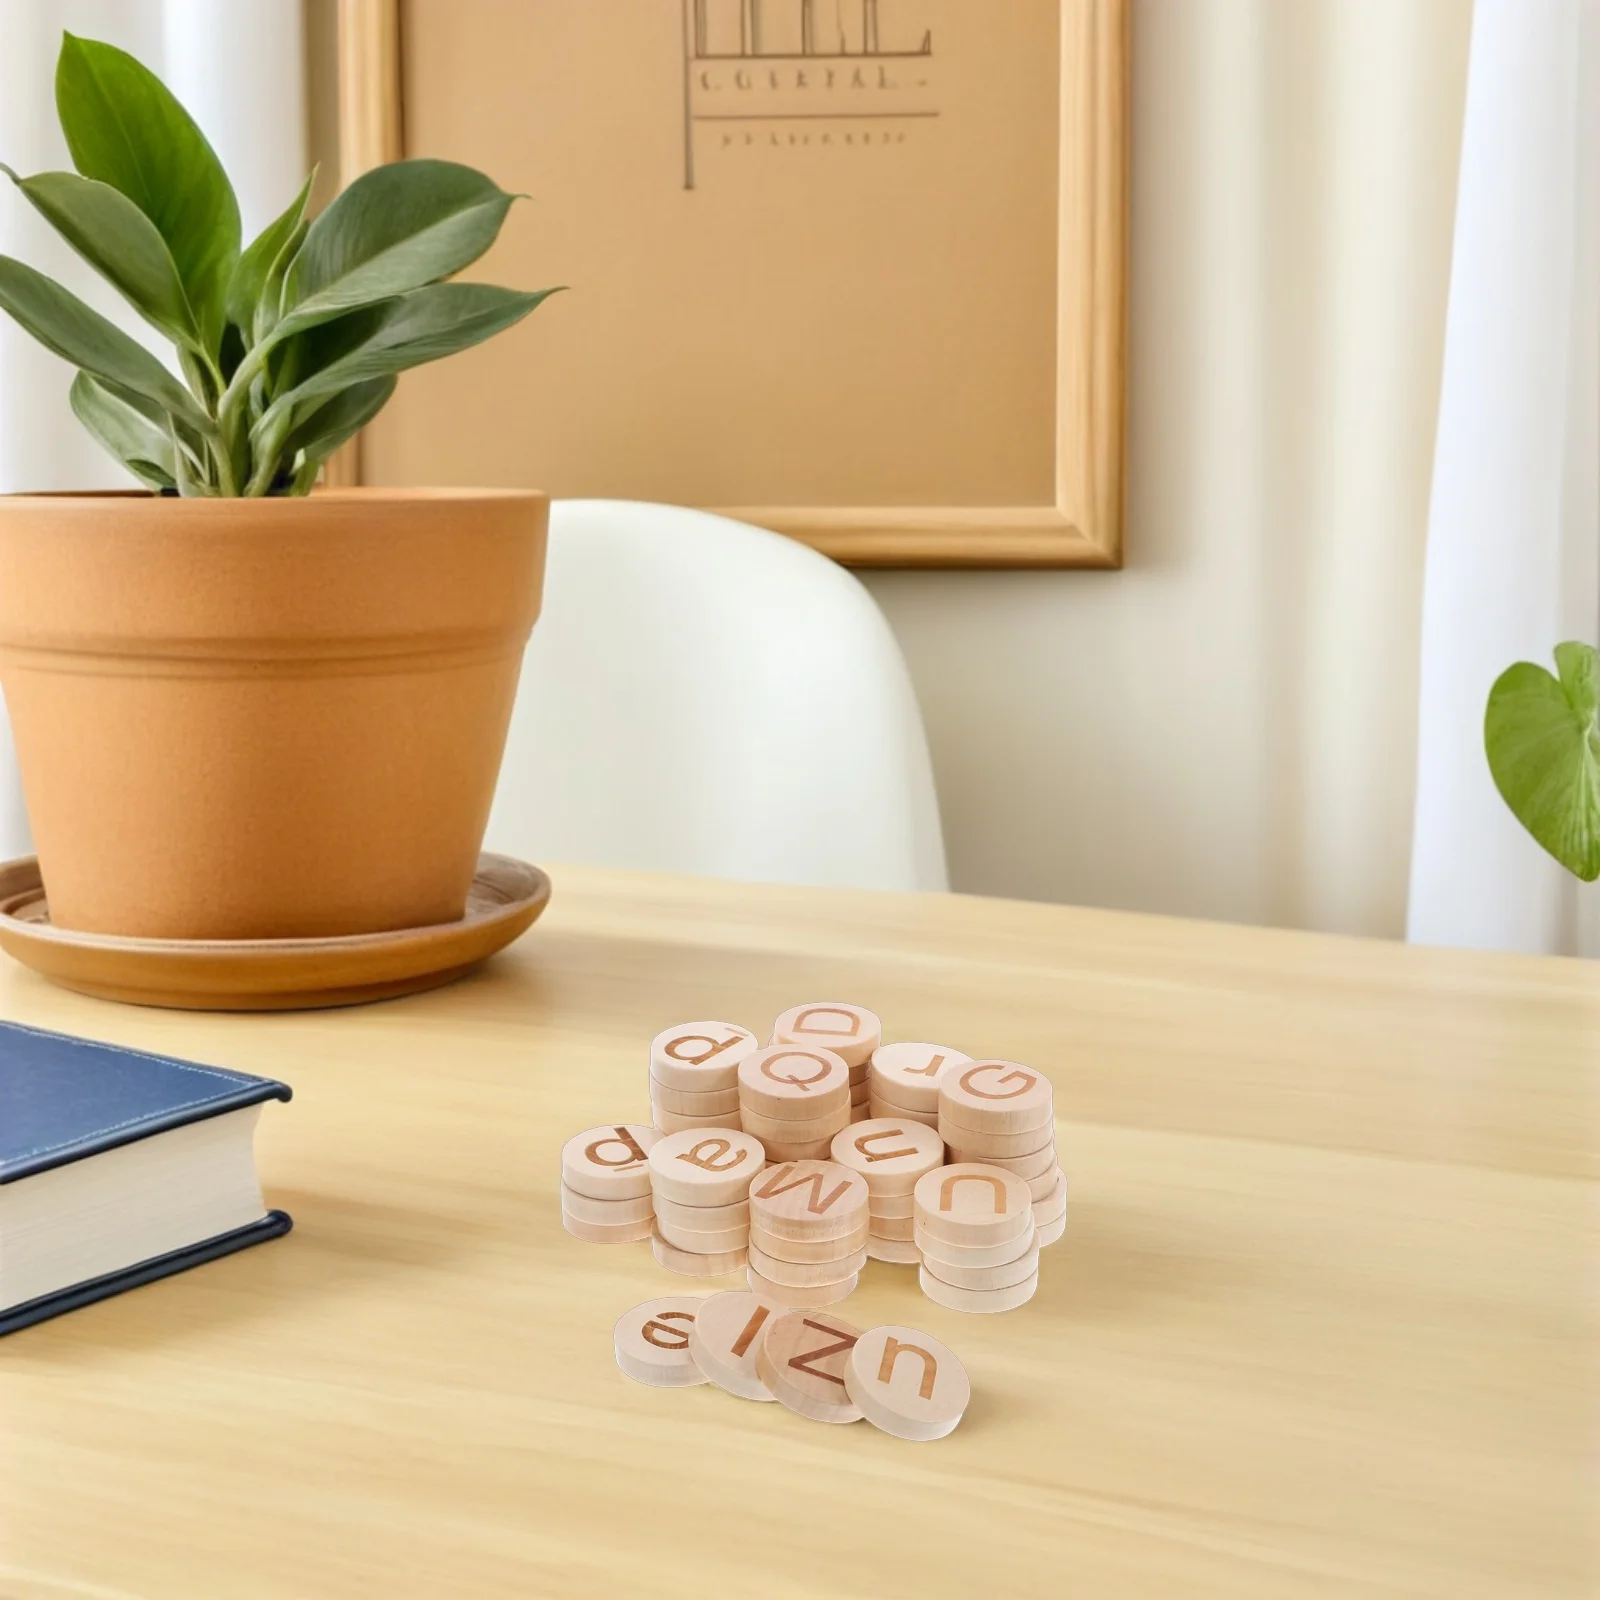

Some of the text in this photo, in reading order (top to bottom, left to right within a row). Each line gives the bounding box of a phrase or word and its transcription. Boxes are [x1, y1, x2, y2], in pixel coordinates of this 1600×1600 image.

[793, 1008, 860, 1036] D
[760, 1051, 832, 1091] Q
[959, 1064, 1037, 1099] G
[877, 1336, 938, 1400] n
